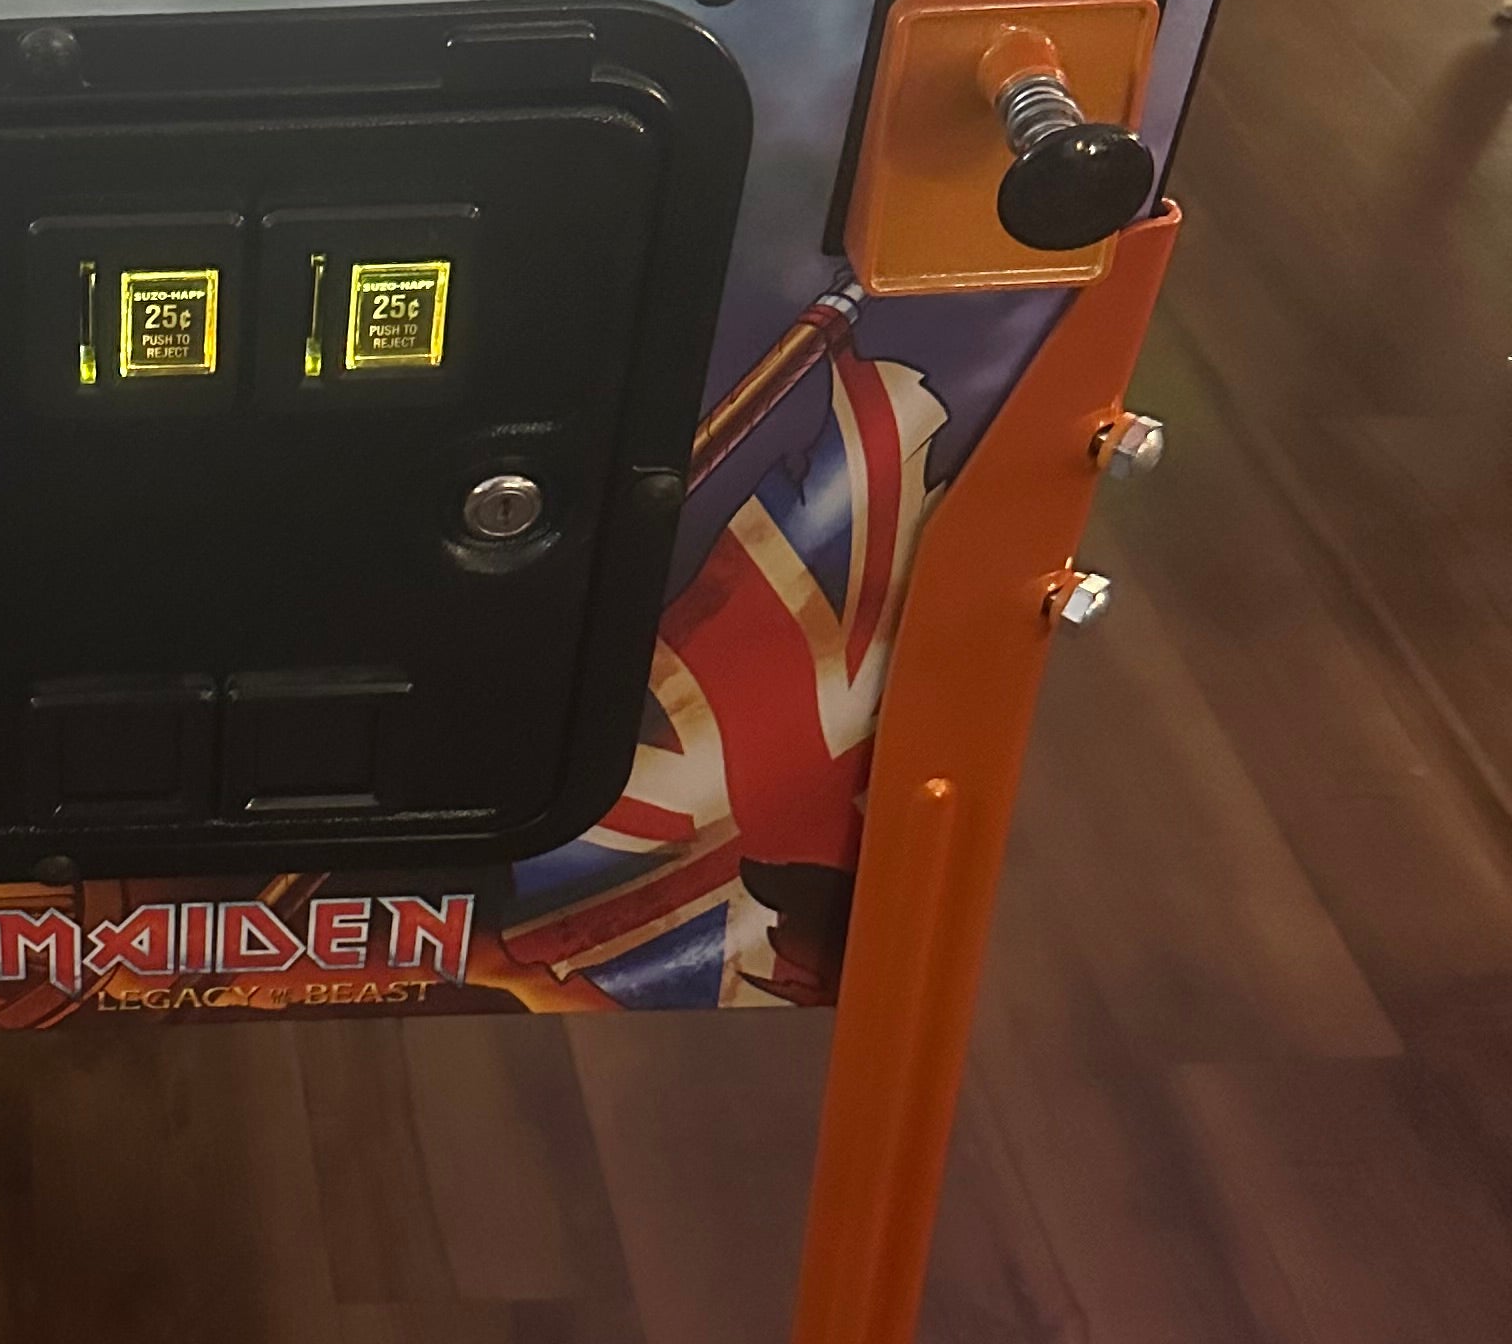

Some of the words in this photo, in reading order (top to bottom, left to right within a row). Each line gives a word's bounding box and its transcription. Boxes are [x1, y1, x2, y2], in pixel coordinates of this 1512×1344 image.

[362, 280, 435, 292] SUZO-HAPP
[133, 290, 206, 302] SUZO-HAPP
[372, 294, 420, 321] 25¢
[144, 304, 192, 331] 25¢
[368, 325, 399, 337] PUSH
[402, 324, 418, 336] TO
[142, 335, 173, 347] PUSH
[176, 334, 191, 346] TO
[372, 337, 415, 350] REJECT
[146, 347, 189, 360] REJECT
[97, 985, 259, 1012] LEGACY
[304, 979, 438, 1006] BEAST
